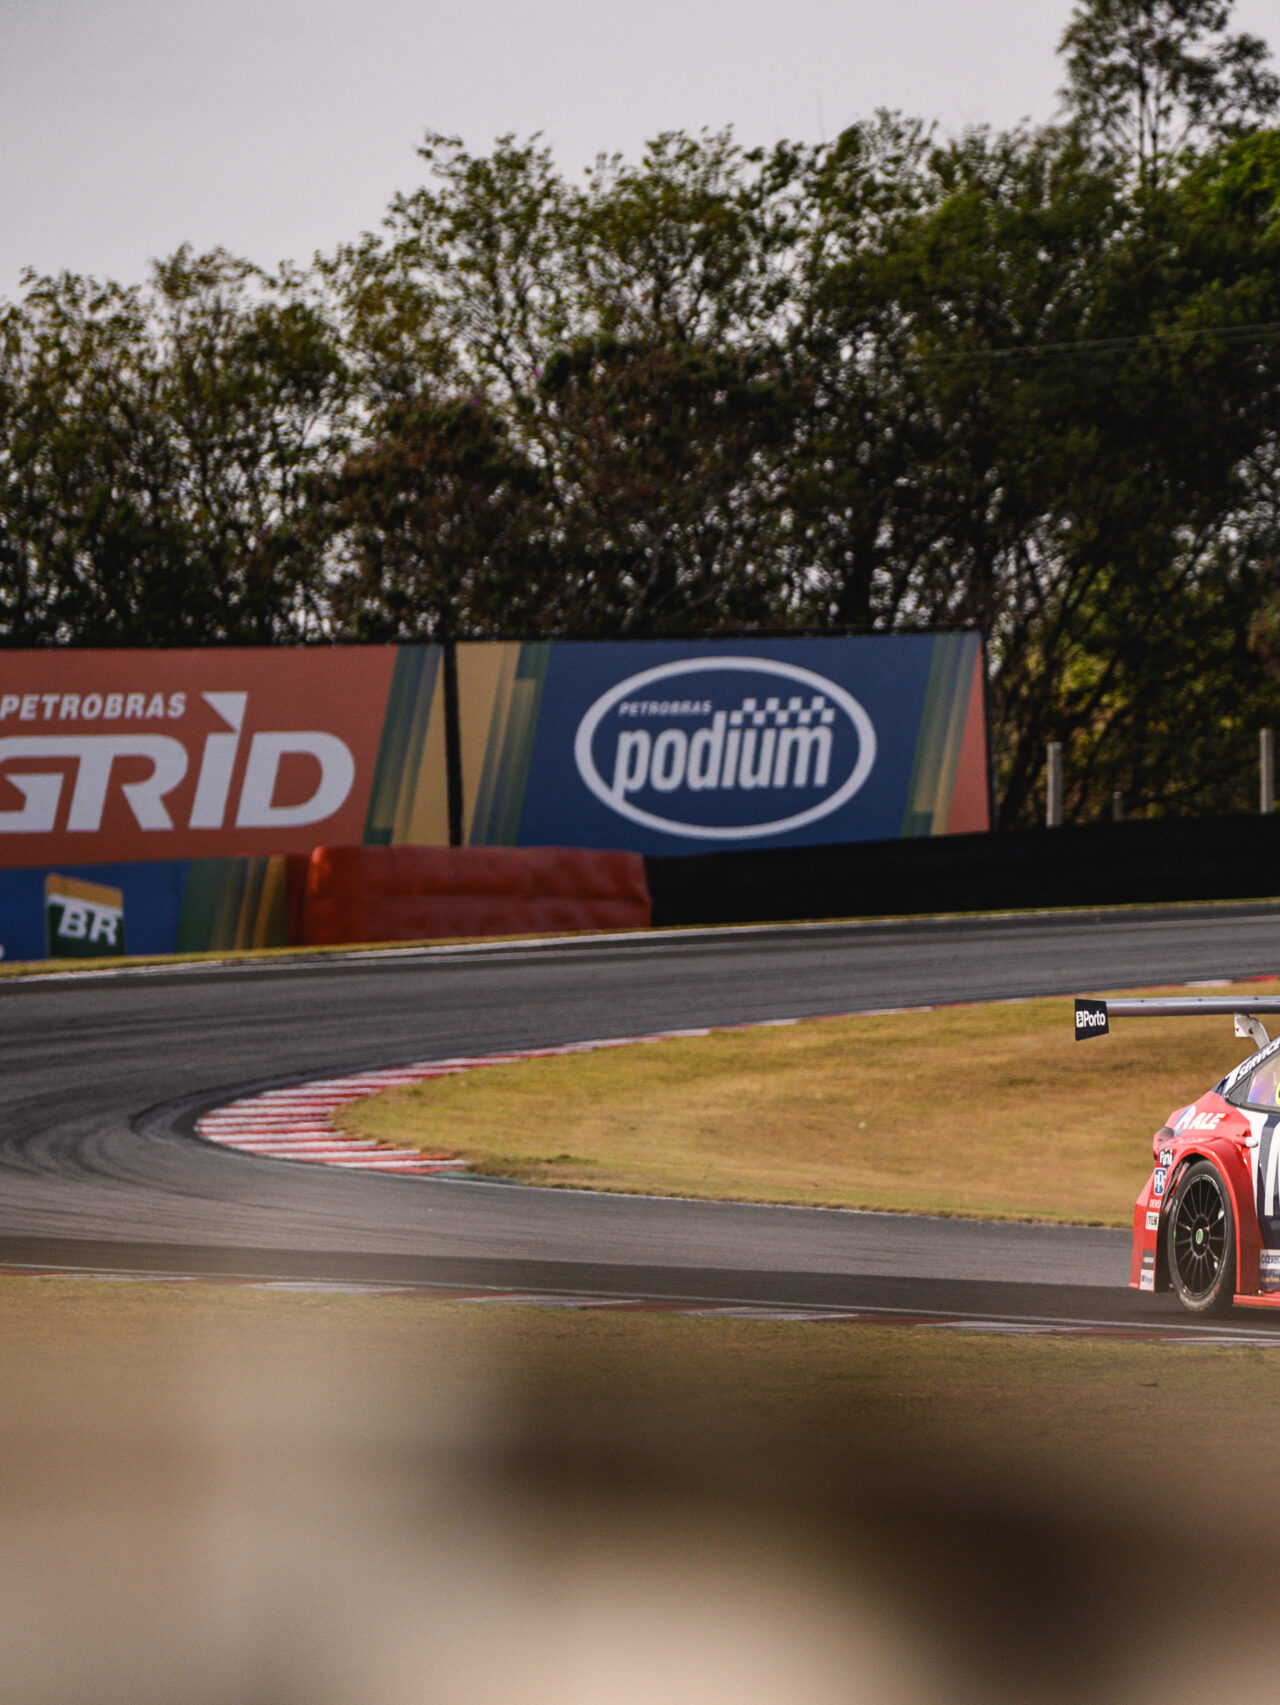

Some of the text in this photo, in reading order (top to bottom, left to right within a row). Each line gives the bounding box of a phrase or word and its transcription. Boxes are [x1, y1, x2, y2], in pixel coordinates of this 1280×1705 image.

[0, 692, 187, 720] PETROBRAS
[618, 700, 713, 718] PETROBRAS
[0, 691, 356, 833] GRID
[611, 708, 834, 801] podium
[57, 905, 119, 945] BR
[1189, 1112, 1226, 1130] ALE
